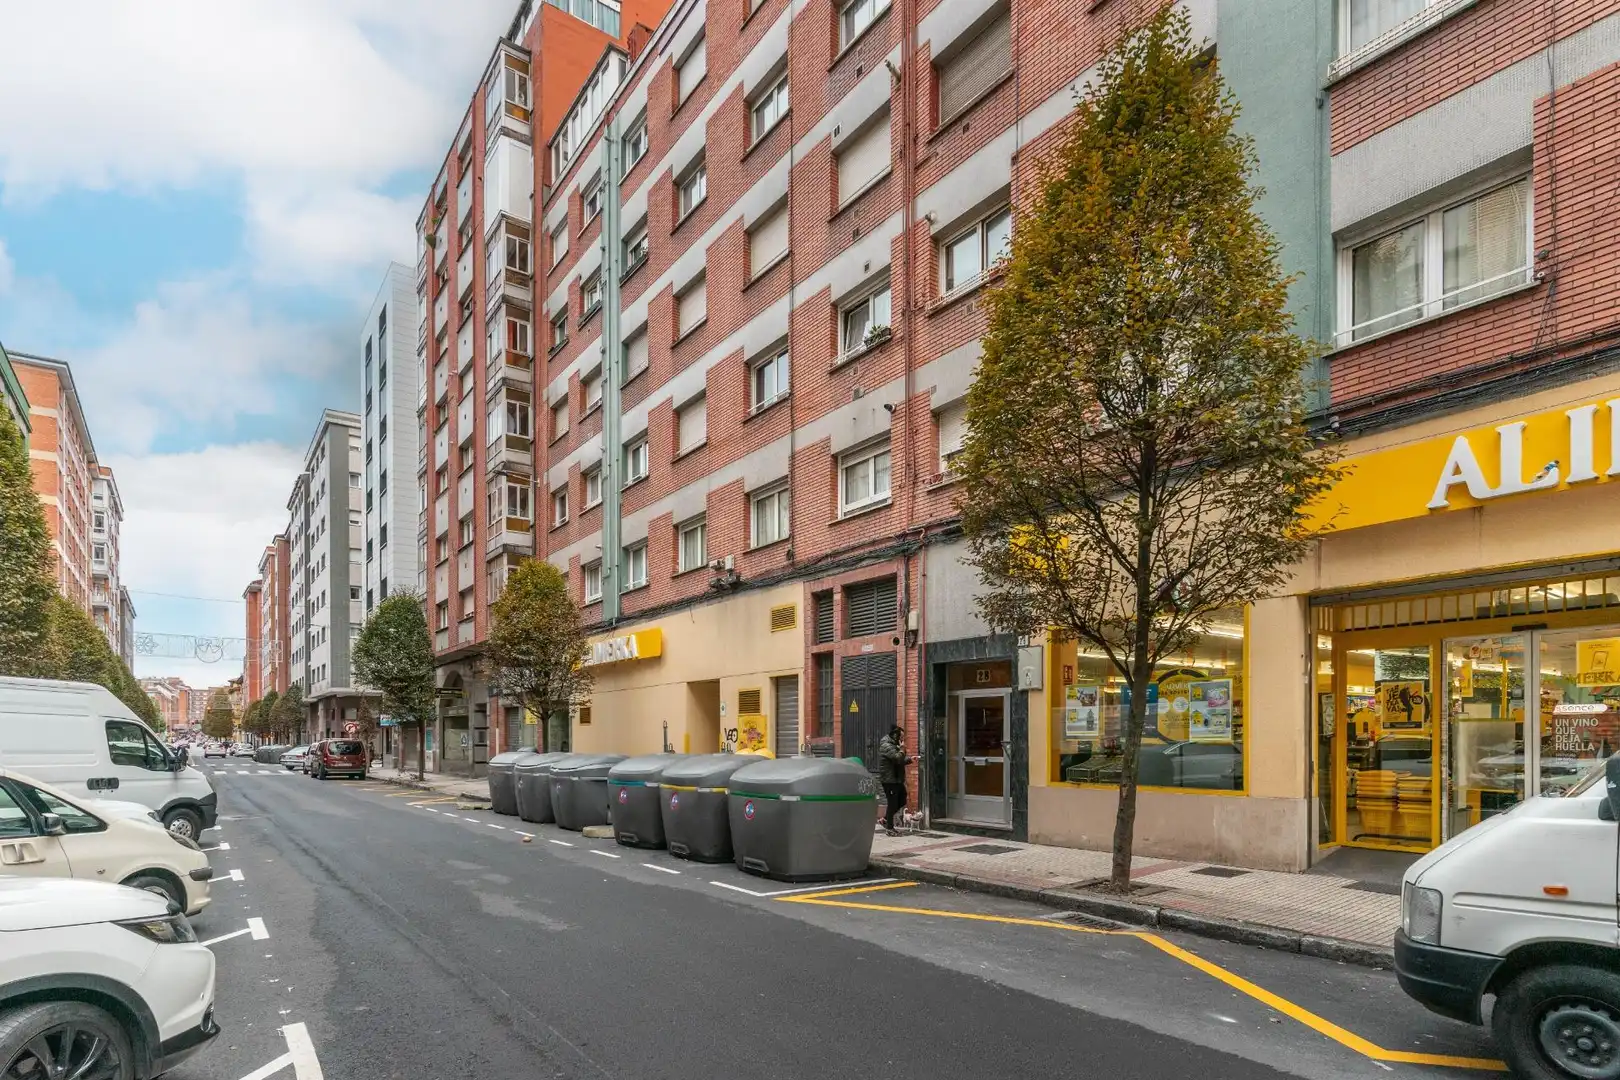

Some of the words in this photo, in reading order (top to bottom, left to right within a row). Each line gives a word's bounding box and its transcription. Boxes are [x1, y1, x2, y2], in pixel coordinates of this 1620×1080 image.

[978, 670, 990, 681] 28
[1555, 719, 1570, 727] UN
[1572, 718, 1599, 727] VINO
[1555, 727, 1576, 735] QUE
[1555, 735, 1580, 743] DEJA
[1555, 743, 1595, 751] HUELLA
